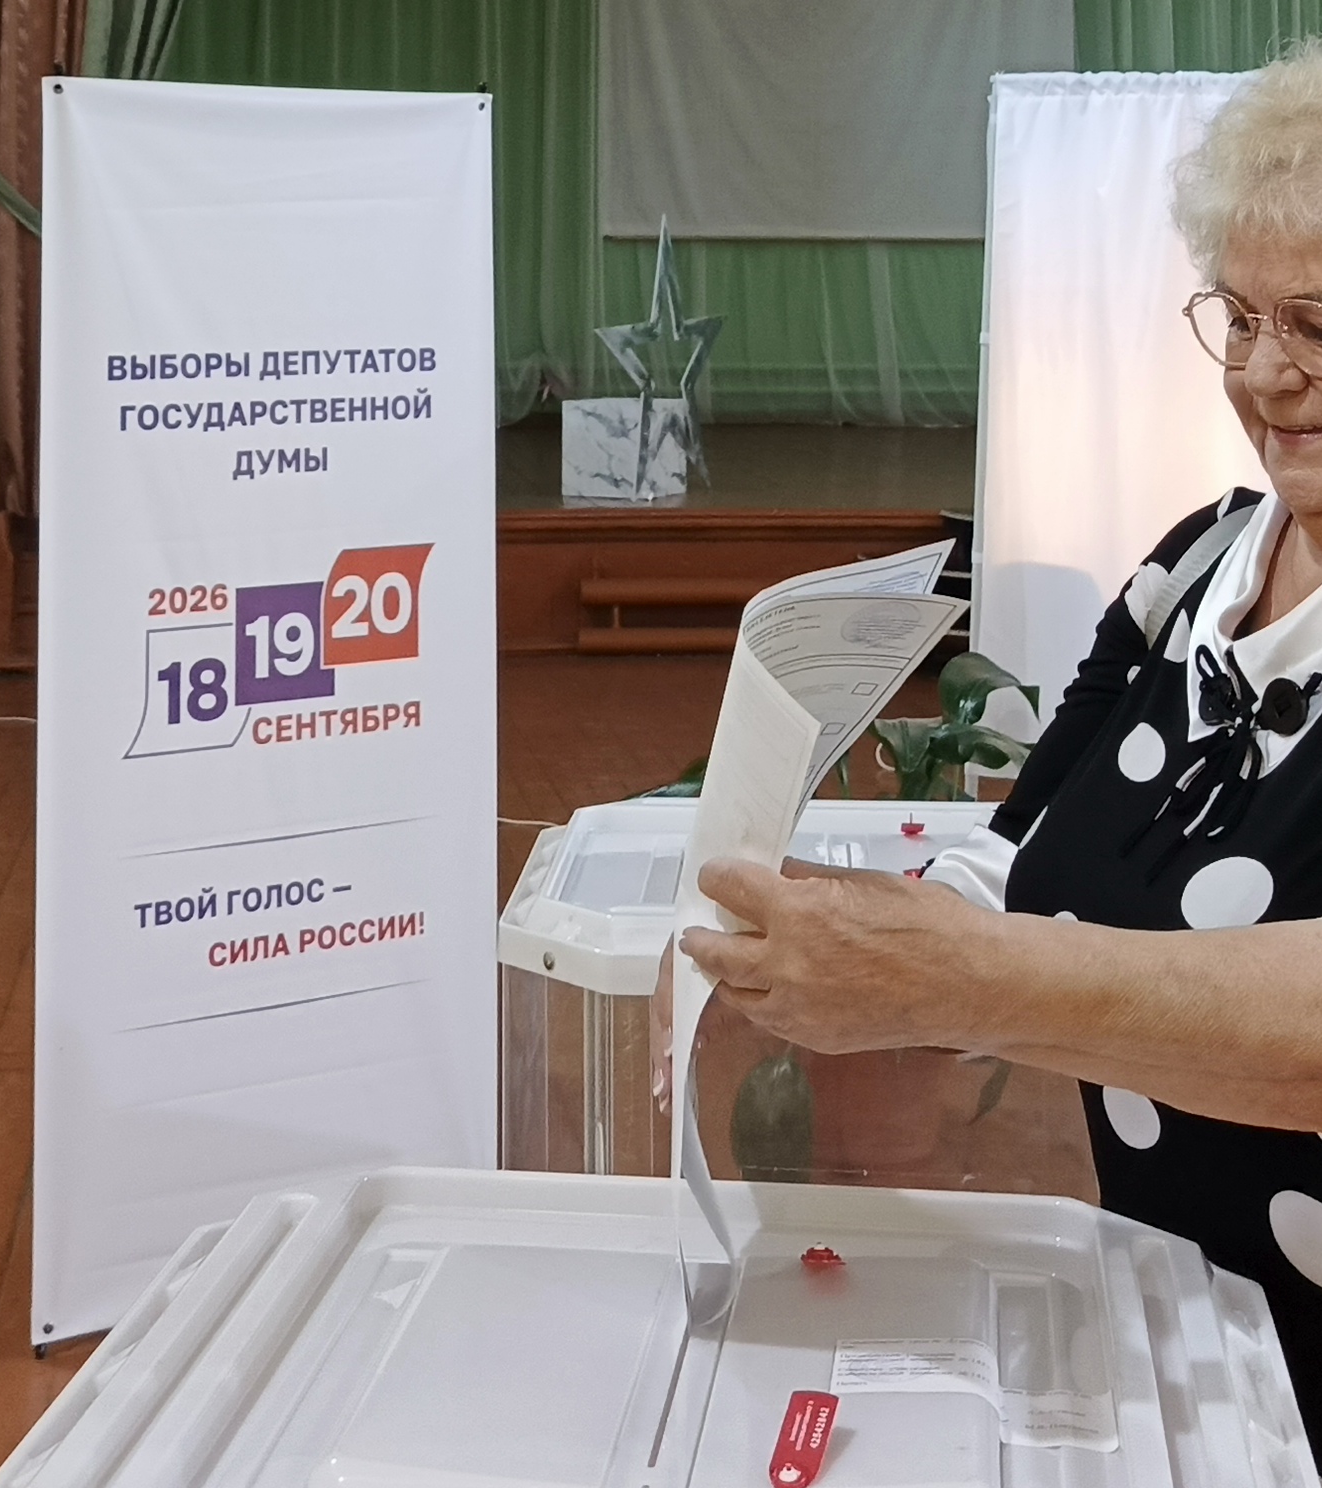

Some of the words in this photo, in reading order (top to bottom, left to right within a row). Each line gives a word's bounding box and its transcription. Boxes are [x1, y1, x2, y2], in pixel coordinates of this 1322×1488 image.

[107, 351, 250, 381] ВЫБОРЫ
[258, 347, 437, 382] ДЕПУТАТОВ
[119, 388, 432, 433] ГОСУДАРСТВЕННОЙ
[232, 446, 328, 480] ДУМЫ
[147, 583, 229, 616] 2026
[157, 658, 229, 725] 18
[245, 613, 315, 679] 19
[330, 573, 412, 639] 20
[252, 700, 421, 745] СЕНТЯБРЯ
[134, 886, 217, 929] ТВОЙ
[226, 877, 325, 916] ГОЛОС
[208, 932, 291, 967] СИЛА
[299, 911, 425, 954] РОССИИ!
